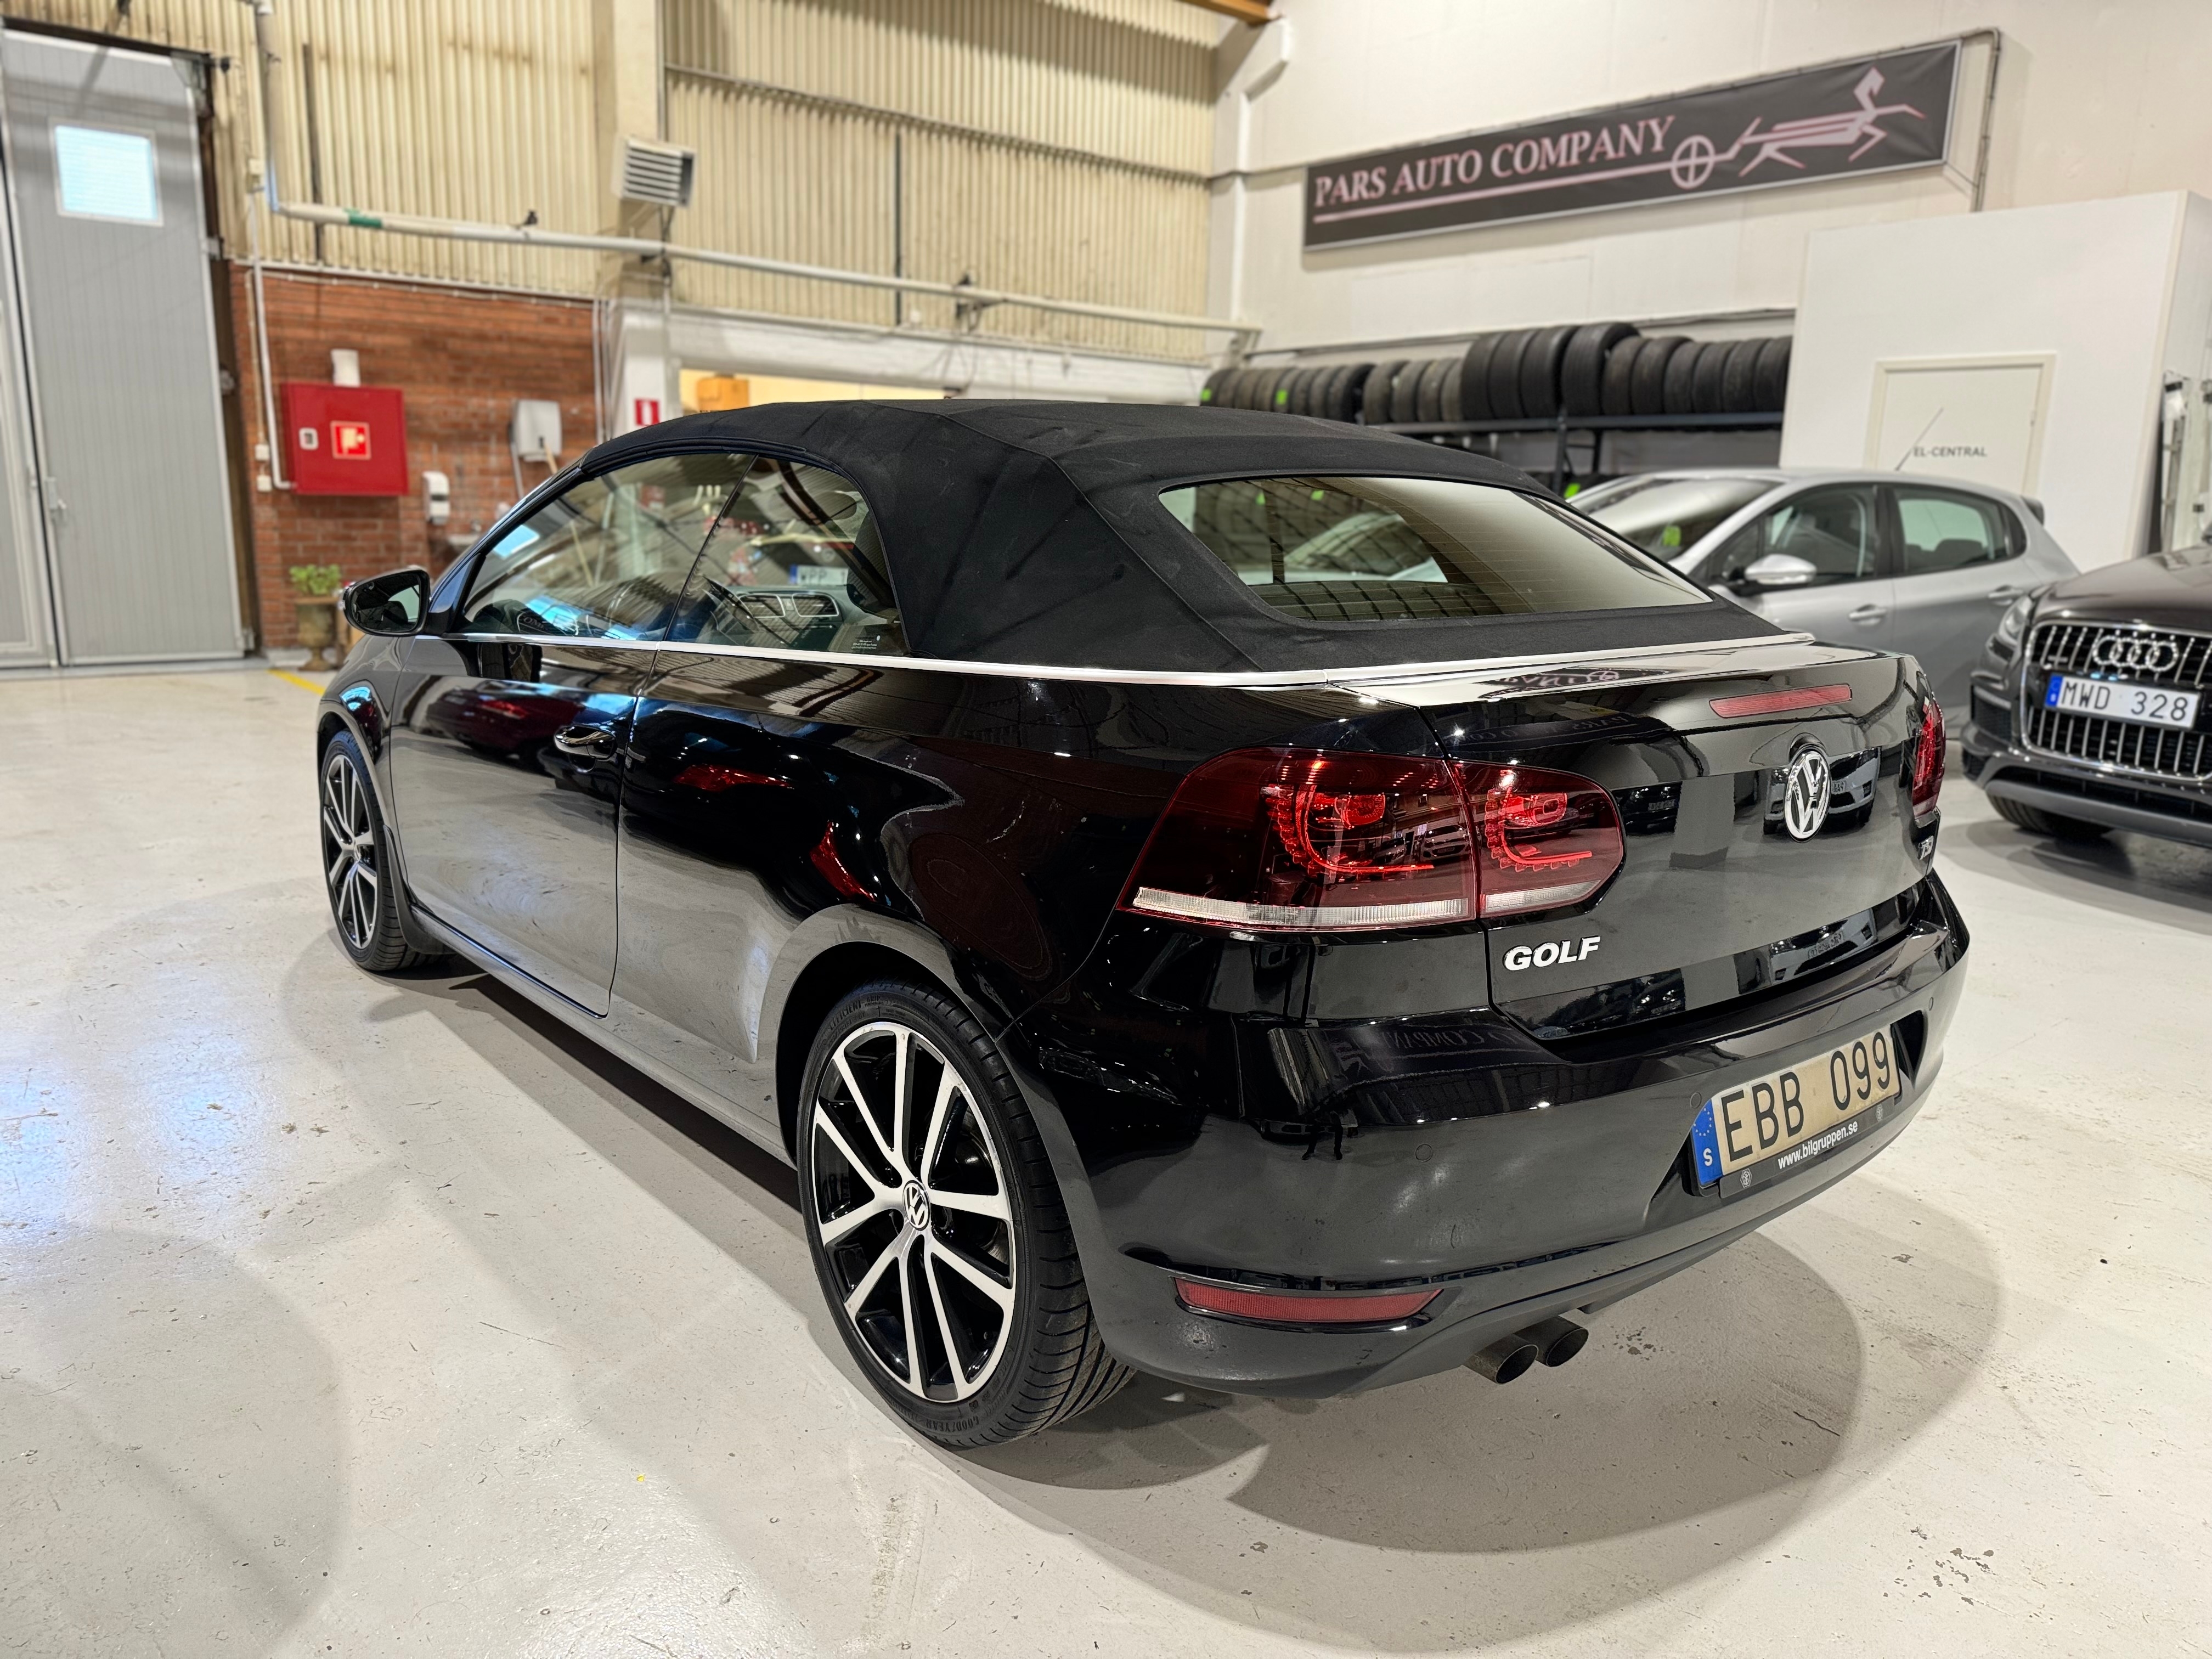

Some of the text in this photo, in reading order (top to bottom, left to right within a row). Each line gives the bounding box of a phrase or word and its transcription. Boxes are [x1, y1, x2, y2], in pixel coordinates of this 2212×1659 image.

[1314, 115, 1675, 207] PARS AUTO COMPANY
[1912, 445, 1987, 458] EL-CENTRAL
[2061, 681, 2189, 721] MWD 328
[1503, 935, 1601, 971] GOLF
[1720, 1031, 1891, 1163] EBB 099
[1703, 1148, 1713, 1167] S
[1778, 1121, 1858, 1170] www.bilgruppen.se
